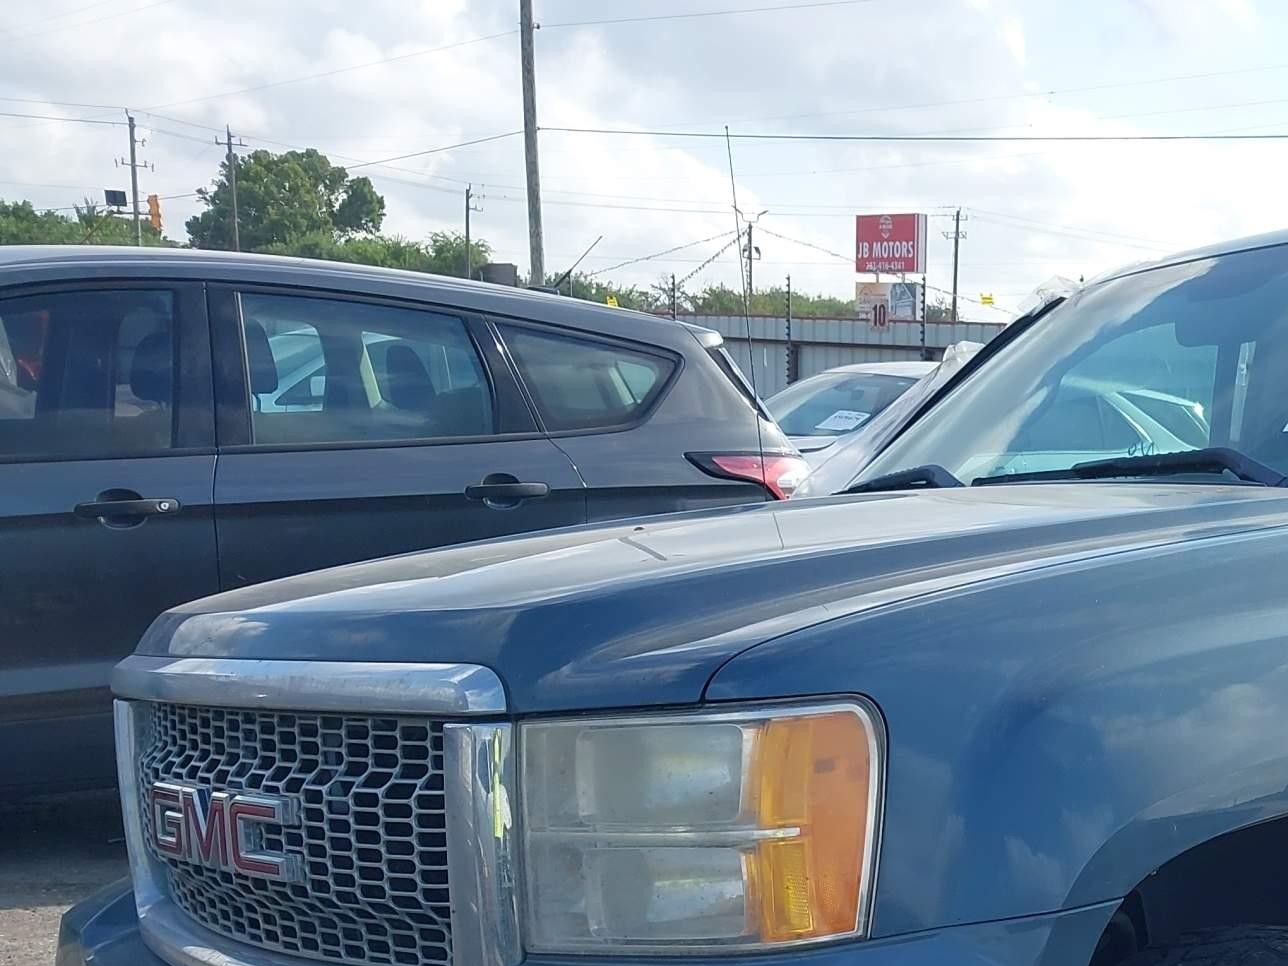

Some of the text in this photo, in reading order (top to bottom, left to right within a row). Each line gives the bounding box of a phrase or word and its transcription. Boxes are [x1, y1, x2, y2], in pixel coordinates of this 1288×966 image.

[858, 241, 914, 258] JB MOTORS
[872, 303, 886, 327] 10
[152, 782, 289, 880] GMC
